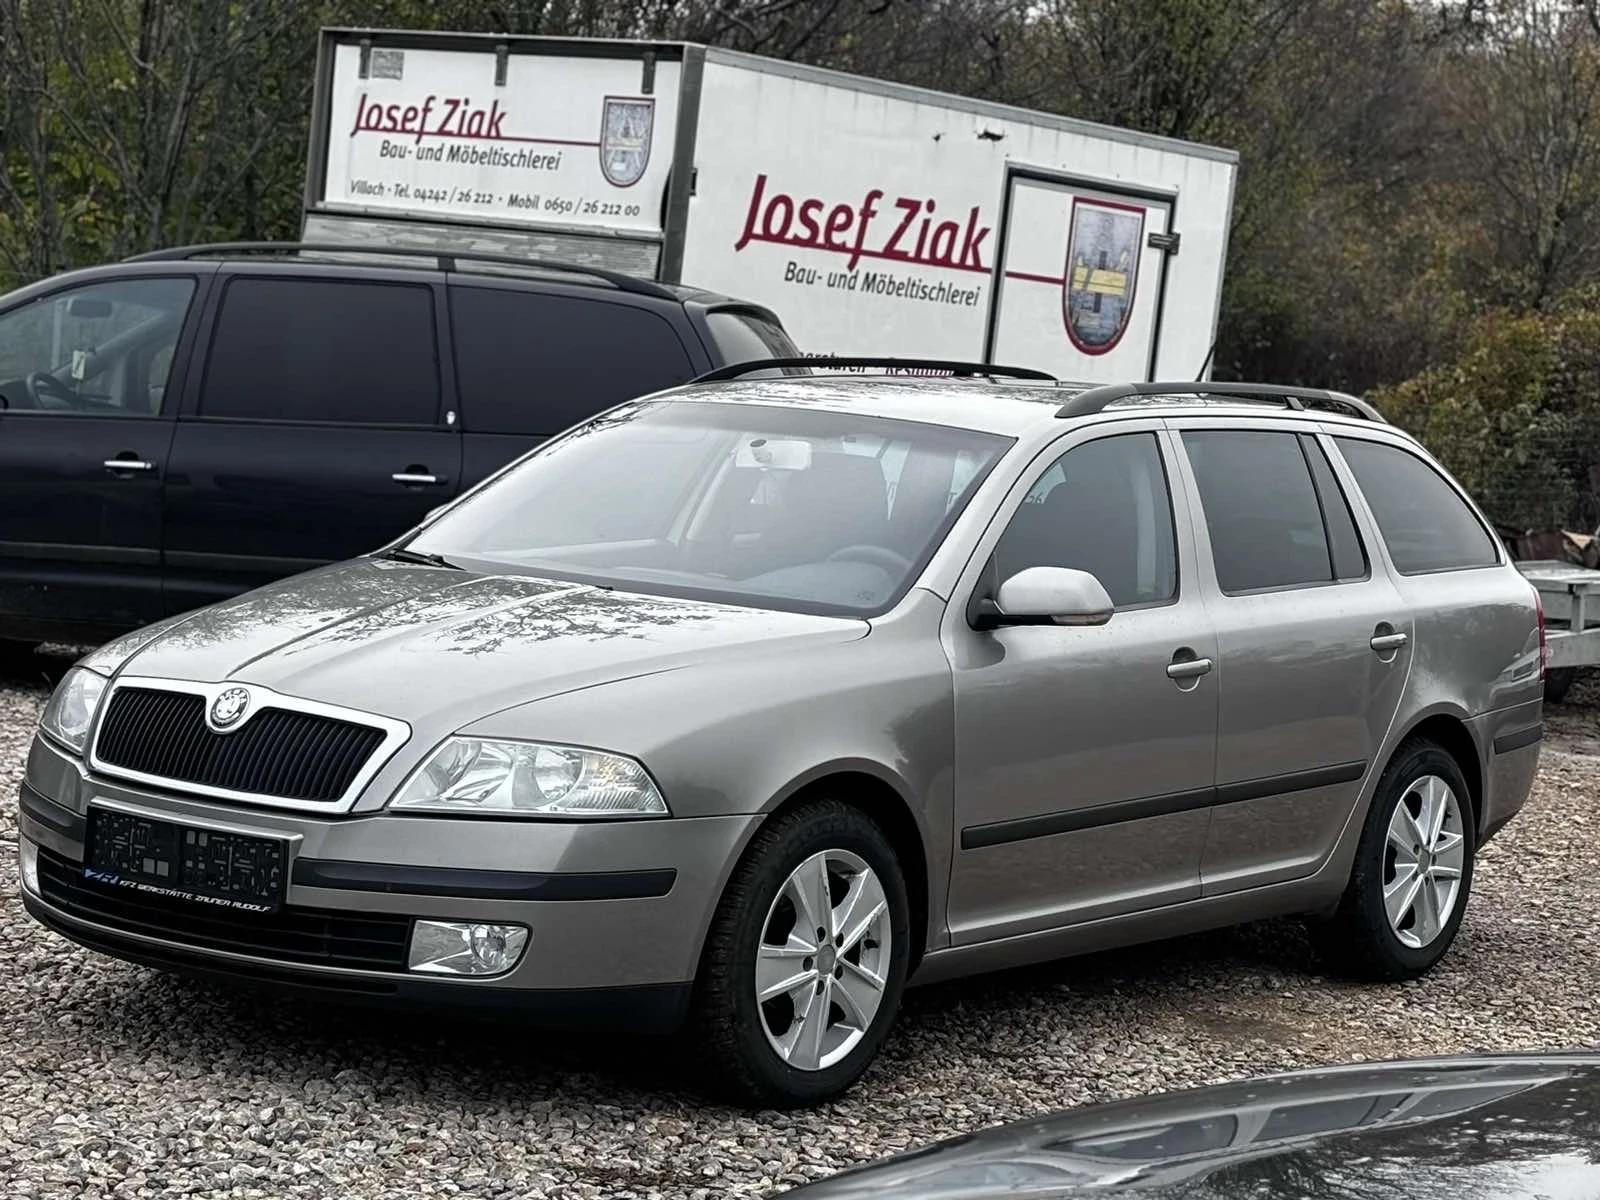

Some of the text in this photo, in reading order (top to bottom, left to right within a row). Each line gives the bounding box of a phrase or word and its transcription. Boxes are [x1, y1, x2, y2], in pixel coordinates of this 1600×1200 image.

[350, 93, 507, 145] Josef Ziak
[380, 139, 561, 170] Bau- und Möbeltischlerei
[350, 180, 385, 196] Villach
[394, 183, 411, 198] Tel.
[413, 187, 448, 203] 04242
[458, 188, 472, 203] 26
[473, 192, 494, 204] 212
[507, 193, 540, 210] Mobil
[544, 196, 573, 214] 0650
[583, 199, 599, 213] 26
[601, 203, 622, 215] 212
[624, 204, 640, 216] 00
[734, 174, 991, 273] Josef Ziak
[784, 261, 982, 306] Bau- und Möbeltischlerei
[232, 901, 271, 912] RUDOLF
